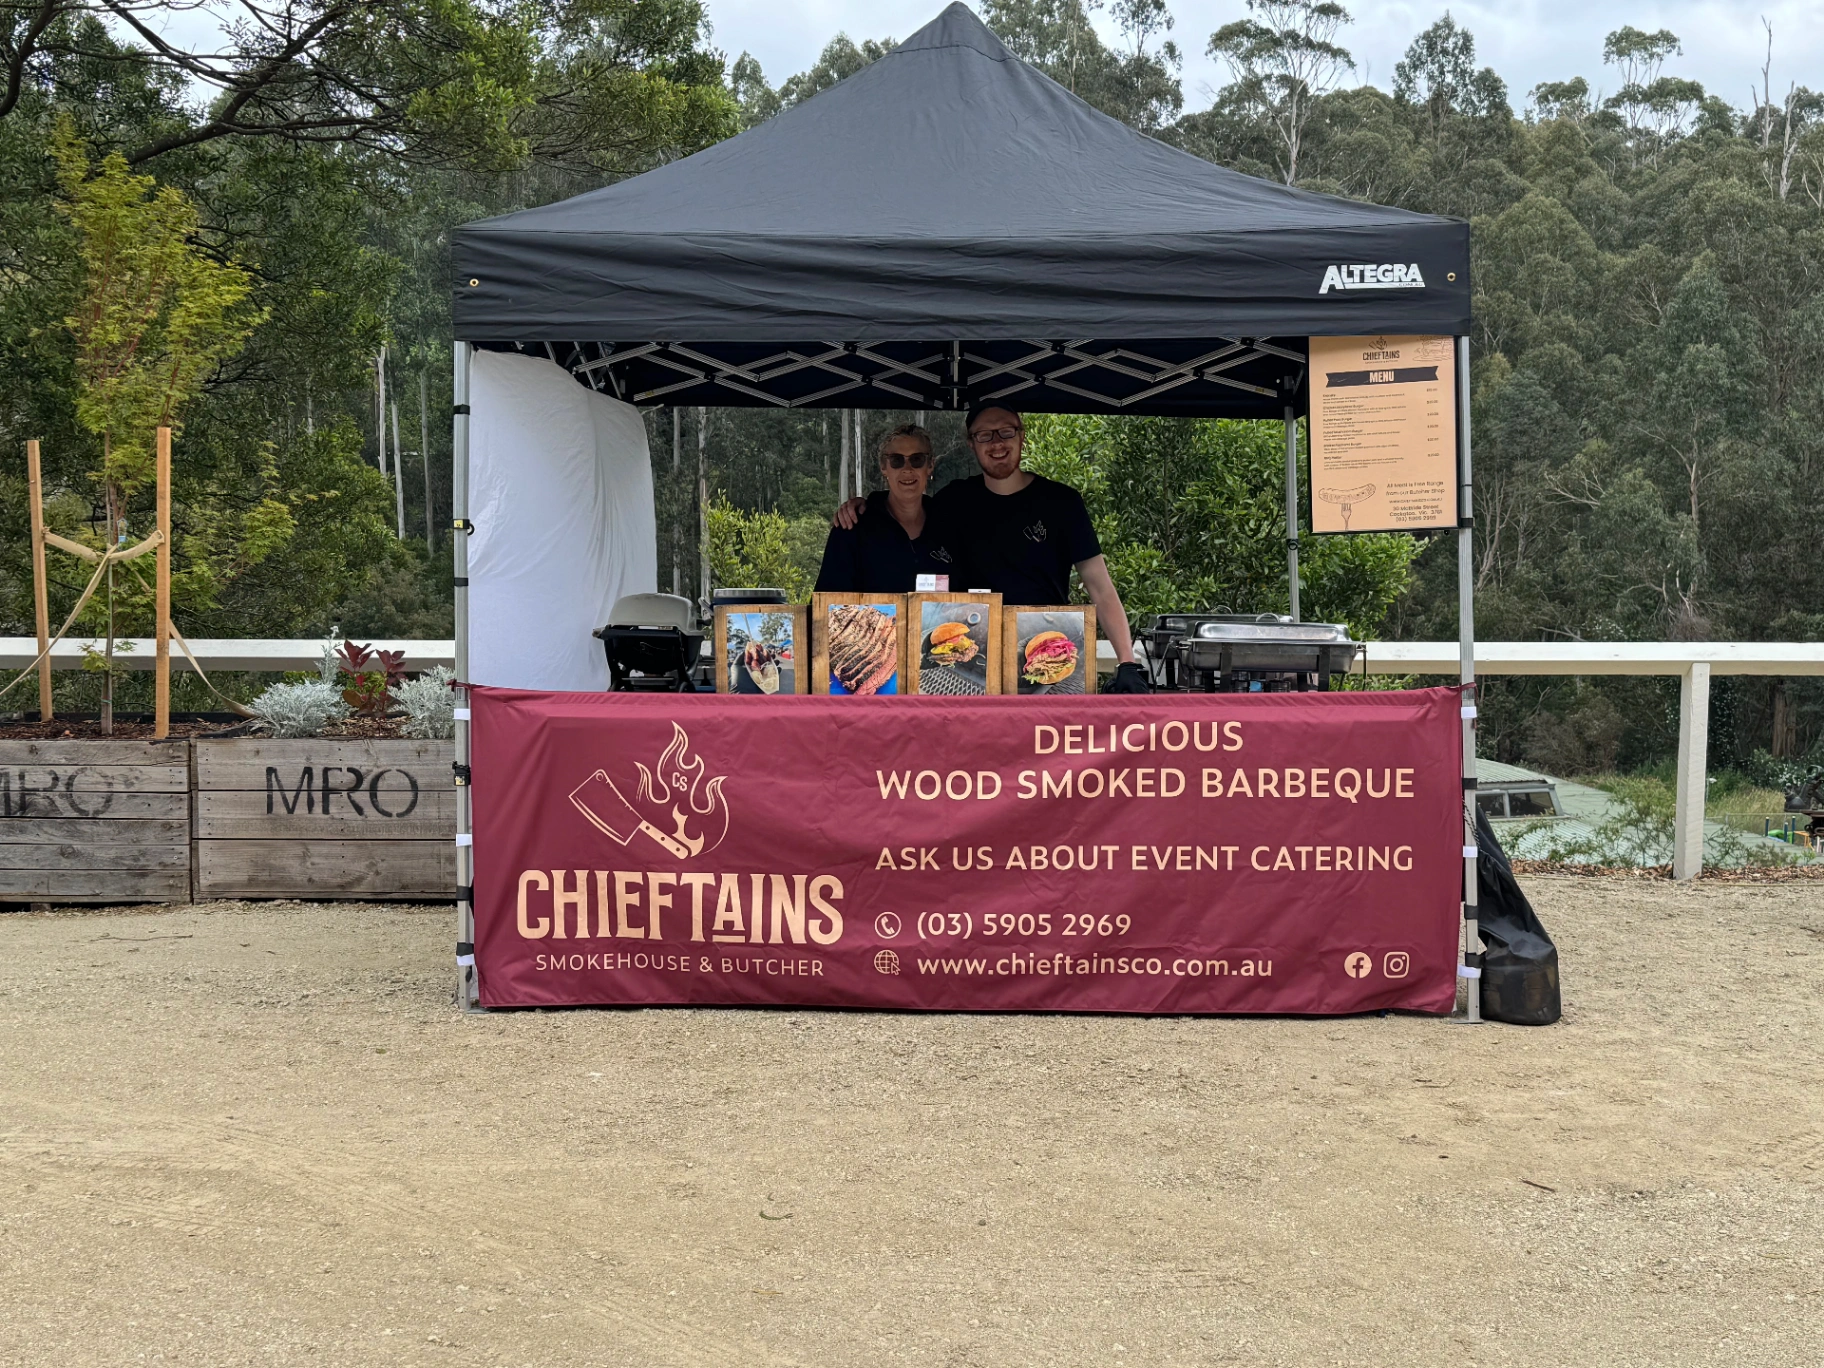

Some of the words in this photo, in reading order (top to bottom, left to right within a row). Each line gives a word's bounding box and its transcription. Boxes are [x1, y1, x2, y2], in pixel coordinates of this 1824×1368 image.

[1318, 263, 1425, 294] ALTEGRA
[1362, 350, 1400, 361] CHIEFTAINS
[1369, 370, 1395, 384] MENU
[1034, 721, 1244, 755] DELICIOUS
[0, 767, 113, 817] RO
[266, 766, 419, 818] MRO
[876, 769, 1002, 801] WOOD
[1016, 768, 1186, 799] SMOKED
[1202, 767, 1415, 804] BARBEQUE
[875, 847, 941, 871] ASK
[952, 847, 994, 871] US
[1005, 846, 1120, 871] ABOUT
[1131, 846, 1240, 871] EVENT
[1250, 845, 1413, 872] CATERING
[517, 869, 844, 945] CHIEFTAINS
[917, 912, 973, 940] (03)
[982, 913, 1052, 936] 5905
[1061, 913, 1132, 936] 2969
[536, 952, 691, 972] SMOKEHOUSE
[699, 956, 714, 973] &
[721, 957, 824, 976] BUTCHER
[917, 952, 1273, 977] www.chieftainsco.com.au
